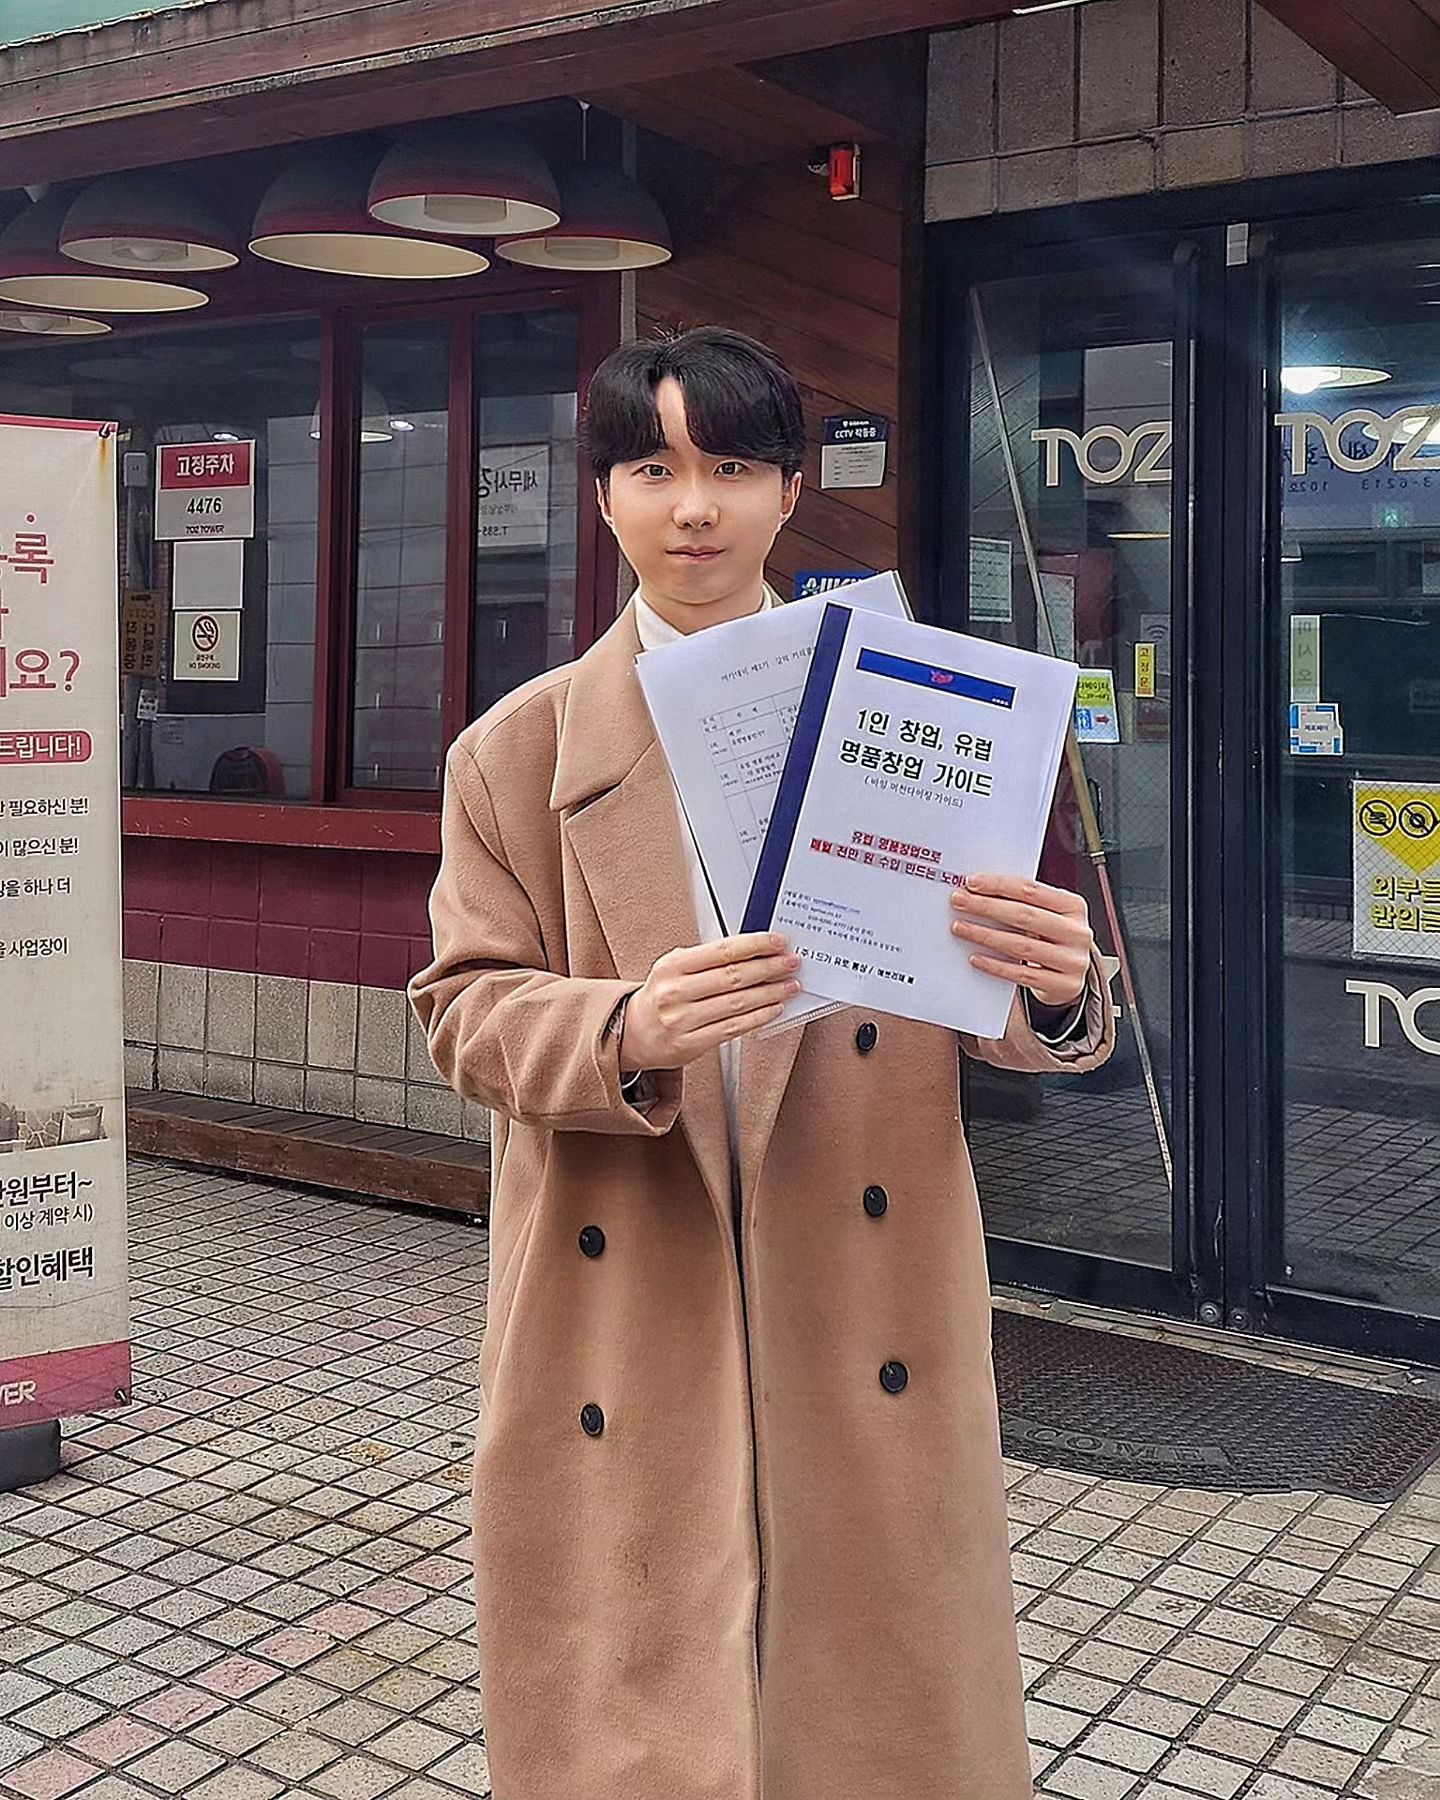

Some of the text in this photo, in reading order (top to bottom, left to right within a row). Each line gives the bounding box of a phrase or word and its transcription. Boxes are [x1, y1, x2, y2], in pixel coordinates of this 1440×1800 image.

[835, 429, 854, 439] CCTV
[1274, 404, 1440, 476] TOZ
[176, 453, 235, 476] 고정주차
[1031, 420, 1172, 487] TOZ
[187, 497, 222, 514] 4476
[0, 534, 55, 584] 록
[0, 646, 80, 698] 요?
[857, 709, 993, 762] 1인 창업, 유럽
[840, 740, 993, 796] 명품창업 가이드
[9, 798, 66, 817] 필요하신
[70, 797, 89, 815] 분!
[13, 838, 56, 857] 많으신
[59, 837, 79, 854] 분!
[0, 877, 71, 897] 을 하나 더
[940, 872, 966, 887] 노하
[9, 937, 68, 958] 사업장이
[0, 1171, 93, 1207] 원부터~
[4, 1203, 93, 1231] 이상 계약 시)
[0, 1380, 36, 1406] ER
